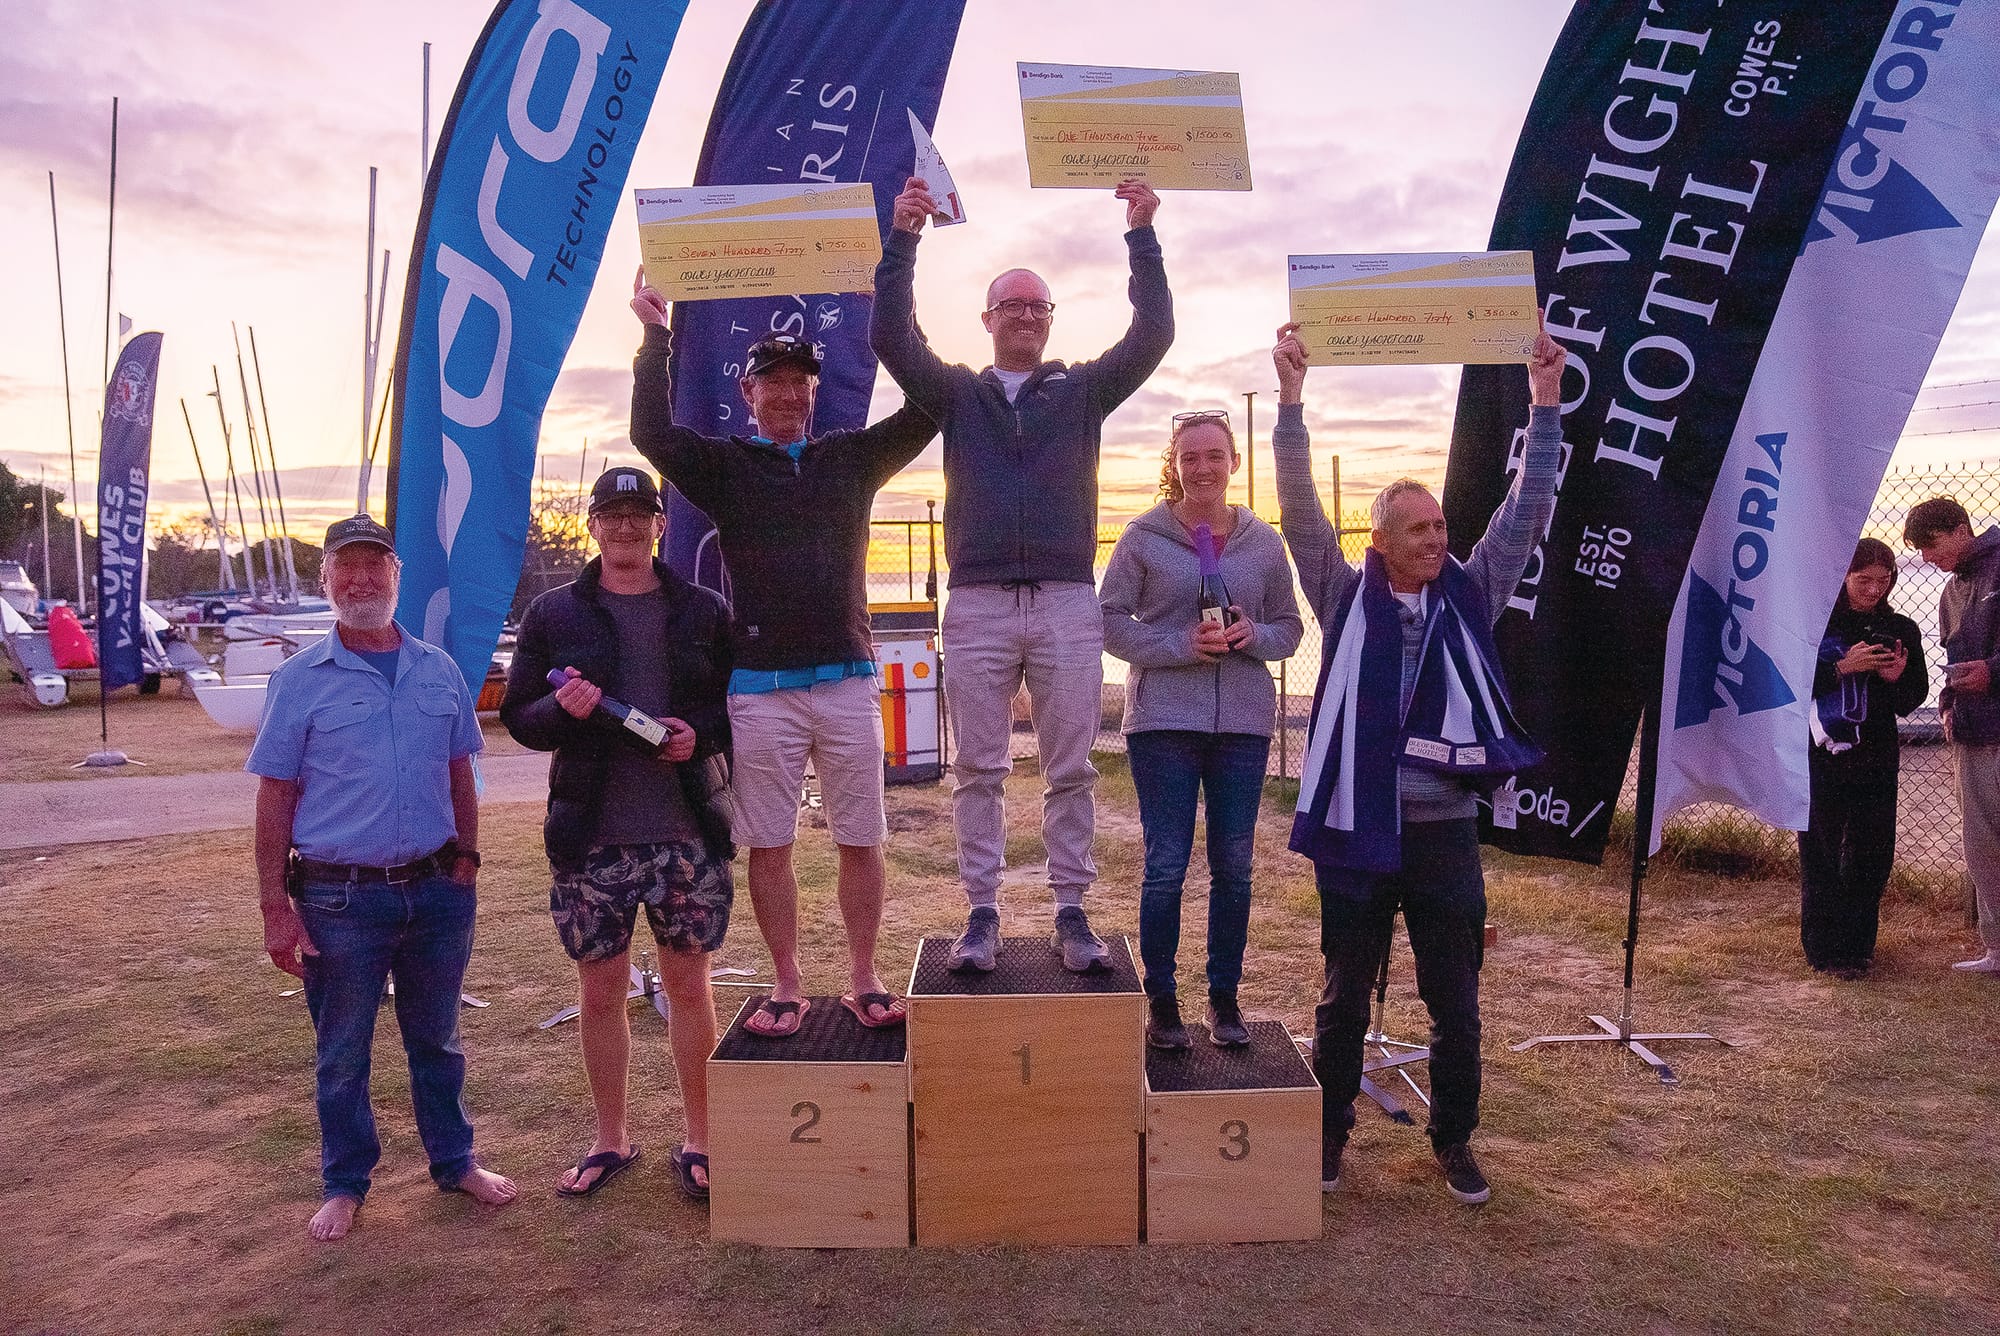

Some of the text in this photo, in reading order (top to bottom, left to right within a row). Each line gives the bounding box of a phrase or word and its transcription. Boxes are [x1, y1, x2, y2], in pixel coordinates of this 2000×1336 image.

[1029, 72, 1050, 80] Bendigo
[1724, 20, 1781, 117] COWES
[1762, 55, 1802, 96] P.I.
[1057, 129, 1159, 143] ONE THOUSAND FIVE
[1136, 143, 1184, 153] HUNDRED
[1185, 130, 1193, 142] $
[1557, 0, 1723, 273] WIGH
[1801, 0, 1962, 257] VICTOR
[547, 41, 639, 288] TECHNOLOGY
[646, 198, 669, 206] Bendigo
[770, 83, 857, 336] SRIS
[947, 192, 960, 219] 1
[680, 246, 717, 258] SEVEN
[723, 244, 772, 256] HUNDRED
[718, 79, 804, 421] USTIAN
[815, 242, 823, 252] $
[1325, 315, 1362, 324] THREE
[1368, 311, 1417, 322] HUNDRED
[1467, 309, 1475, 320] $
[1593, 160, 1768, 481] HOTEL
[815, 340, 827, 360] BY
[122, 466, 146, 545] CLUB
[1574, 524, 1608, 577] EST.
[1595, 527, 1633, 590] 1870
[1708, 432, 1789, 723] VICTORIA
[1011, 1042, 1032, 1086] 1
[789, 1101, 822, 1144] 2
[1218, 1119, 1252, 1162] 3
